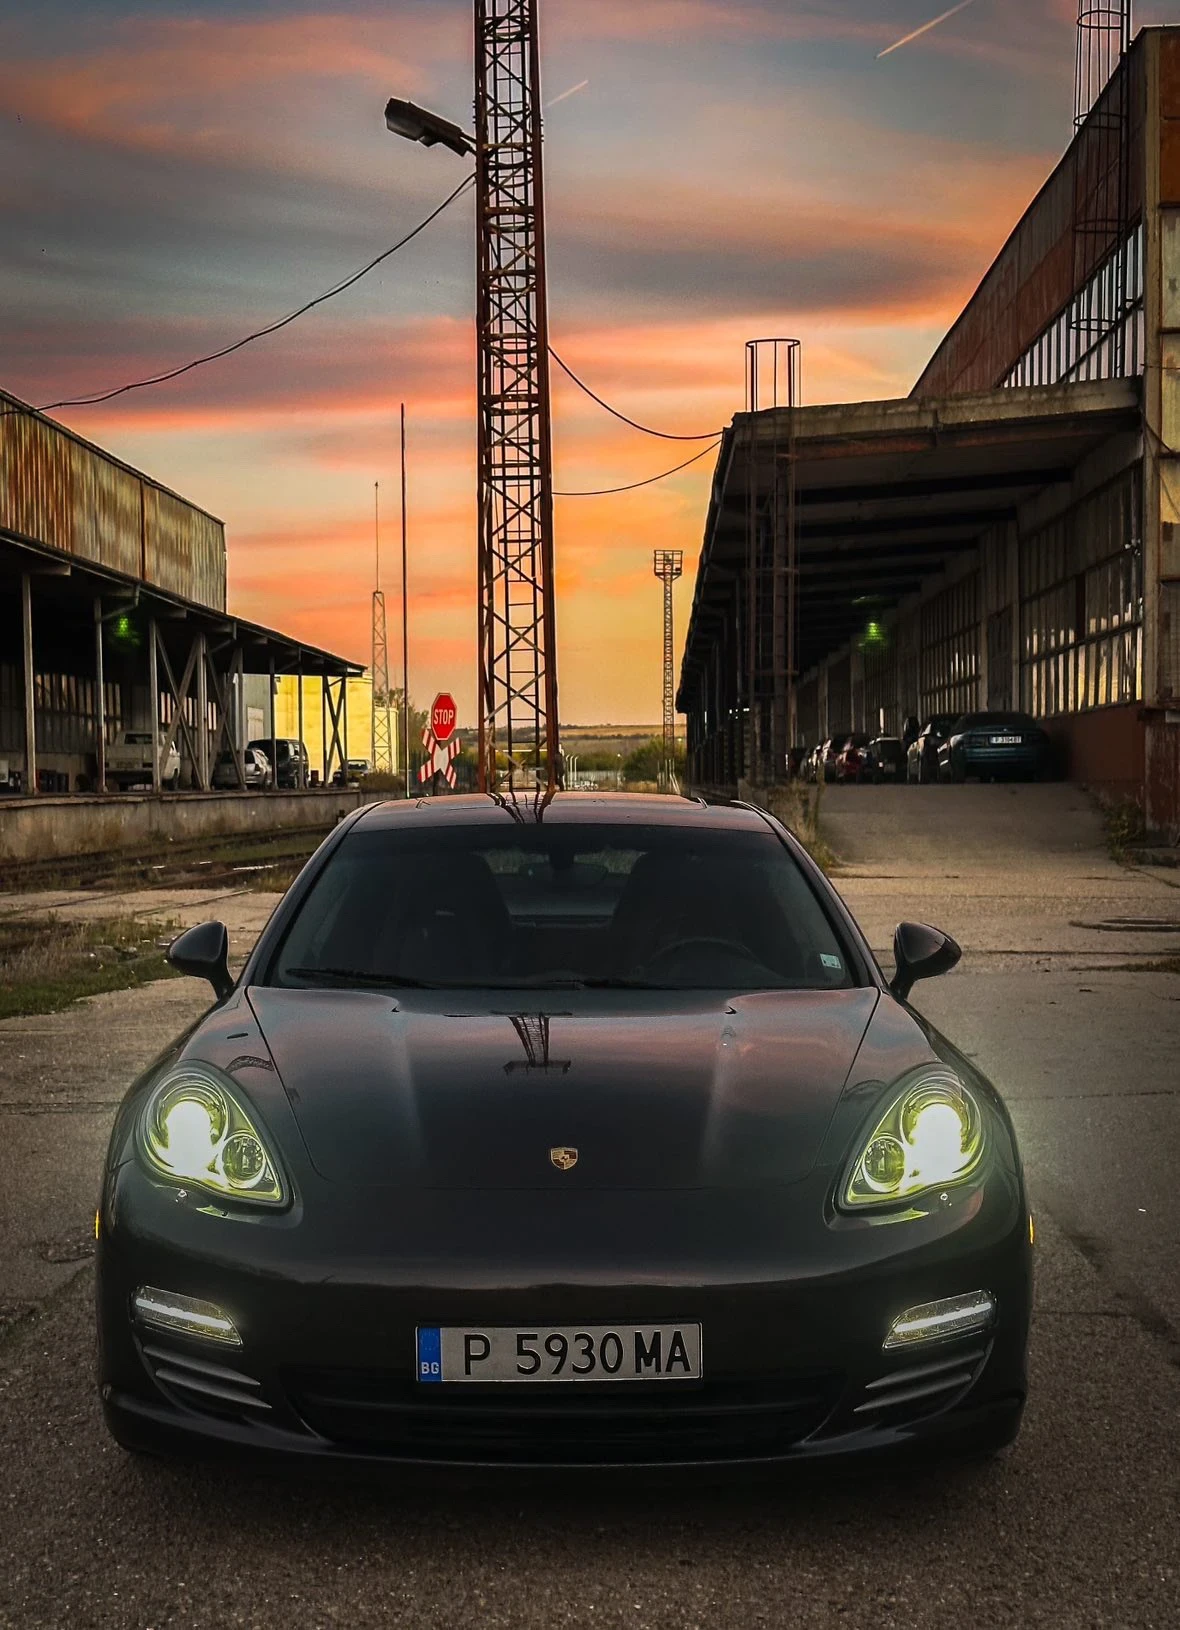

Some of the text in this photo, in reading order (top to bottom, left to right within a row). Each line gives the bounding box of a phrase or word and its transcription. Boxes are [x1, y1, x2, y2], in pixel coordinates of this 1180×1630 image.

[434, 709, 454, 724] STOP
[464, 1330, 691, 1375] P 5930 MA
[421, 1361, 439, 1374] BG
